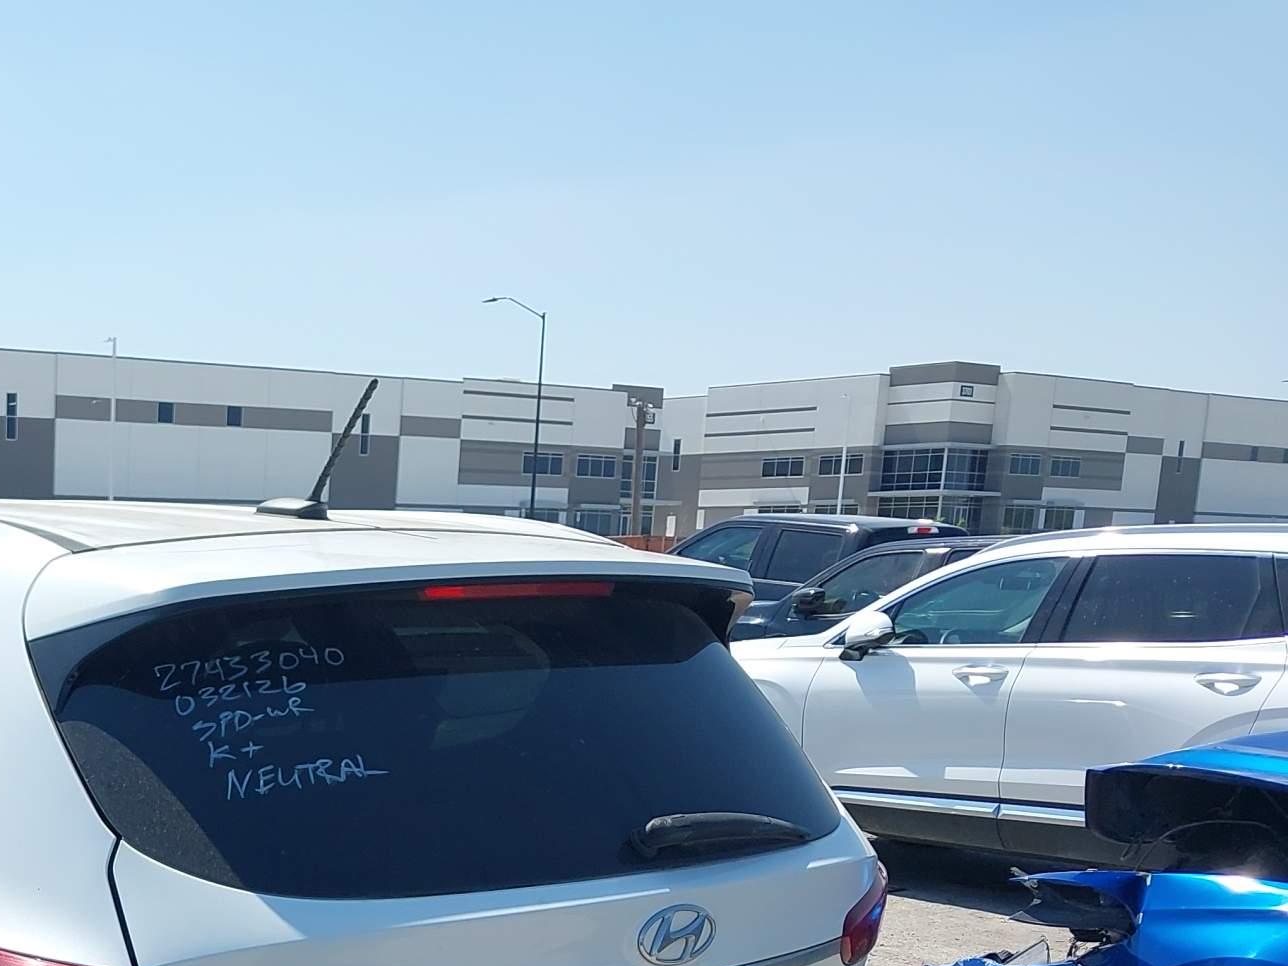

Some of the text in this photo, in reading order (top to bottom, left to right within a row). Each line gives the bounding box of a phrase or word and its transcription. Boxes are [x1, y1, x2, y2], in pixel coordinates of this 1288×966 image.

[154, 647, 345, 691] 27433040
[174, 675, 307, 716] 032126
[226, 753, 390, 801] NEUTRAL
